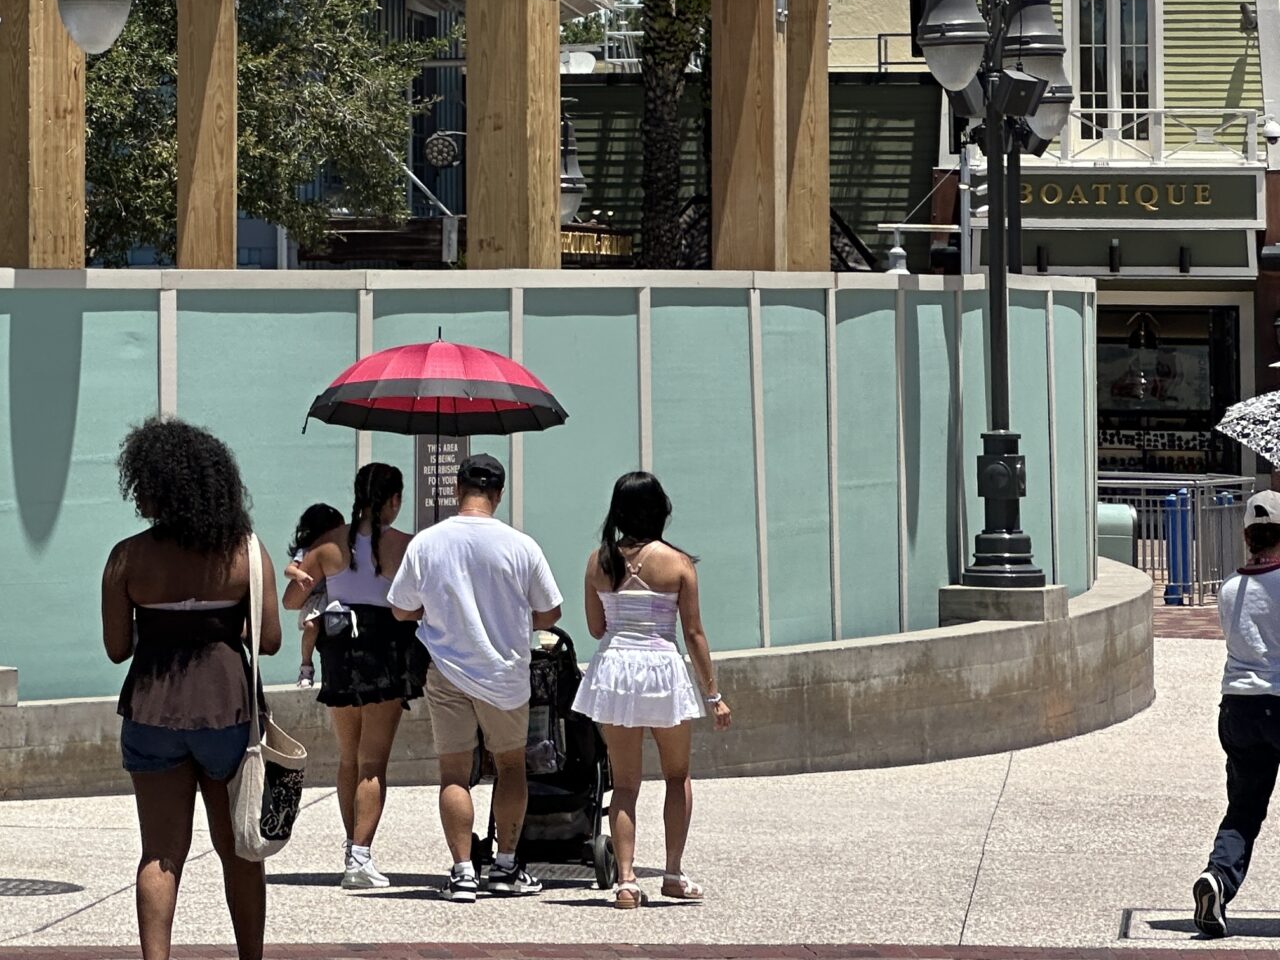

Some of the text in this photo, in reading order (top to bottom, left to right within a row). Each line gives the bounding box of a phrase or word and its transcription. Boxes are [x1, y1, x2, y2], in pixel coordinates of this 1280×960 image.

[1021, 183, 1213, 212] BOATIQUE
[443, 443, 458, 452] AREA
[430, 454, 456, 464] IS BEING
[431, 486, 454, 496] FTURE
[425, 497, 459, 507] ENYMENT
